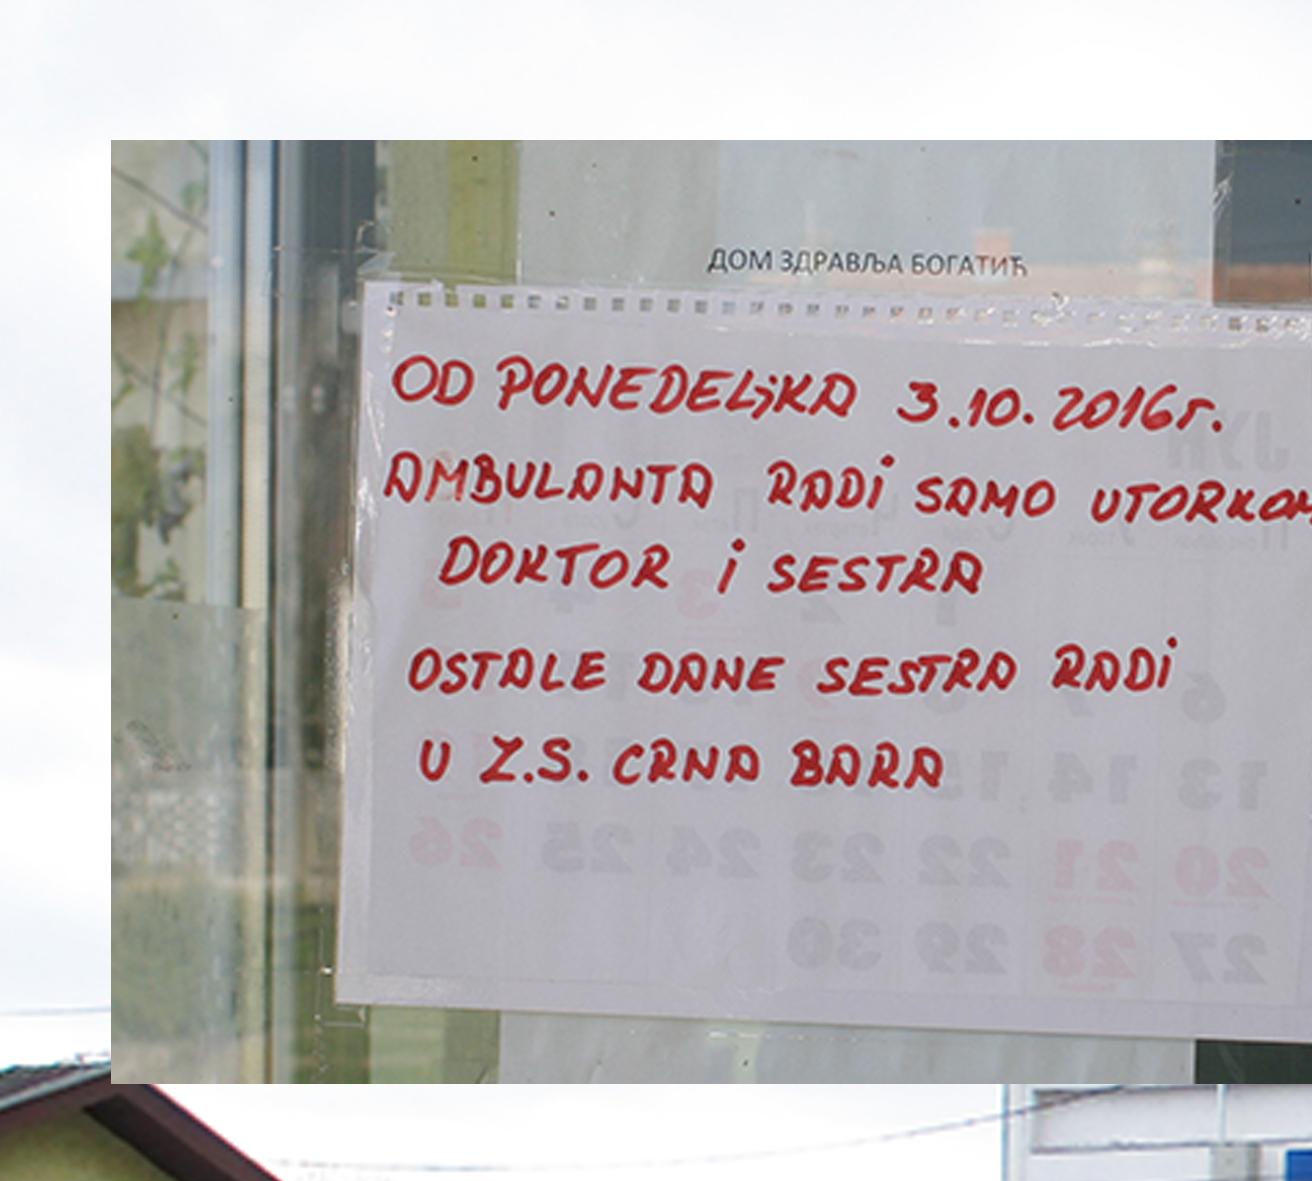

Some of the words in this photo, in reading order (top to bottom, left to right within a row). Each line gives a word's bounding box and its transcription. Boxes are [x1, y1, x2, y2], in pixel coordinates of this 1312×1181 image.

[707, 248, 773, 275] ДОМ
[779, 250, 903, 276] ЗДРАВЉА
[911, 252, 1028, 278] БОГАТИЋ
[391, 354, 476, 406] OD
[383, 450, 715, 509] AMBULANTA
[914, 475, 1057, 518] SAMO
[438, 535, 672, 590] DOKTOR
[766, 547, 984, 596] SESTRA
[408, 646, 607, 695] OSTALE
[637, 652, 786, 695] DANE
[814, 647, 1018, 698] SESTRA
[419, 736, 453, 783] U
[479, 735, 590, 784] Z.S.
[611, 738, 761, 786] CRNA
[789, 739, 945, 789] BARA
